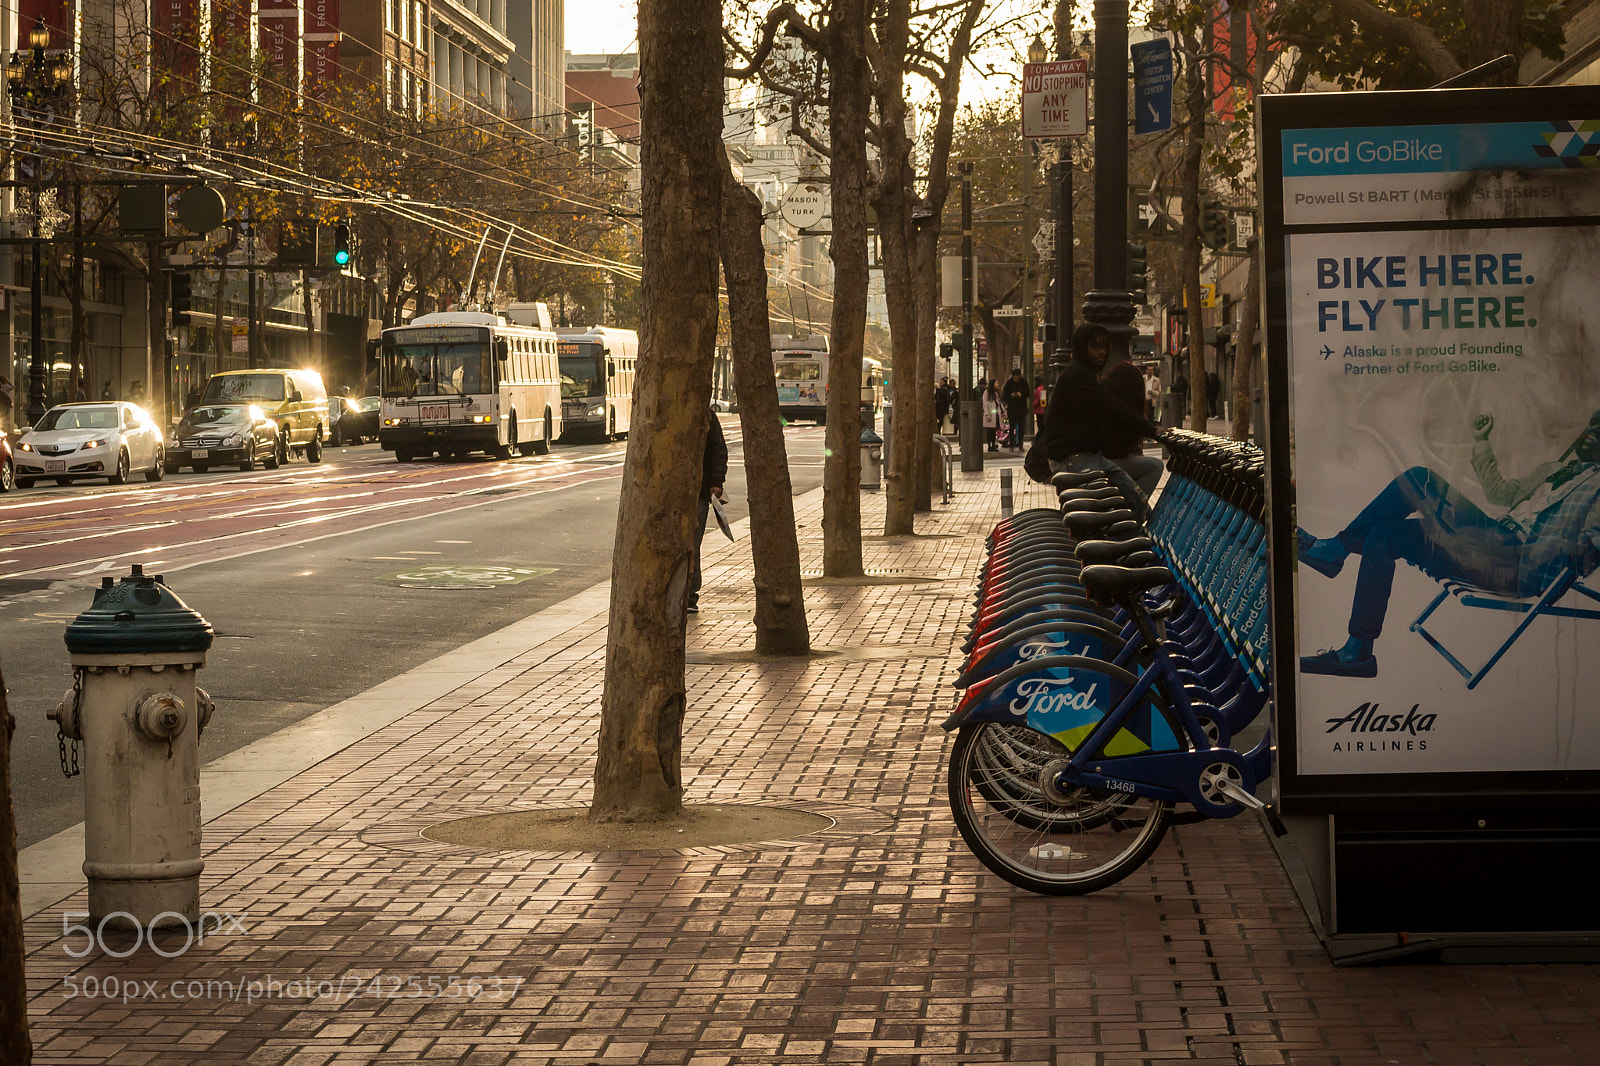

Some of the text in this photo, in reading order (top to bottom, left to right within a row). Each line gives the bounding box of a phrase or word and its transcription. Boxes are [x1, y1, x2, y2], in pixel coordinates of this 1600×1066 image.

[274, 24, 284, 67] LEVELS
[1030, 62, 1082, 75] TOW-AWAY
[1024, 75, 1085, 92] NO STOPPING
[1042, 94, 1068, 107] ANY
[1041, 109, 1070, 123] TIME
[1292, 138, 1443, 165] Ford GoBike
[788, 196, 818, 204] MASON
[1295, 191, 1345, 205] Powell
[1348, 192, 1364, 204] St
[1367, 190, 1409, 203] BART
[1317, 252, 1535, 290] BIKE HERE.
[1318, 295, 1538, 333] FLY THERE.
[1343, 341, 1523, 358] Alaska is a proud Founding
[1343, 359, 1501, 375] Partner of Ford GoBike.
[1222, 587, 1236, 609] Ford
[1231, 565, 1264, 621] Ford GoBike
[1240, 610, 1259, 635] Ford
[1009, 676, 1098, 716] Ford
[1325, 701, 1438, 736] Alaska
[1333, 740, 1428, 752] AIRLINES
[1104, 779, 1136, 793] 13468
